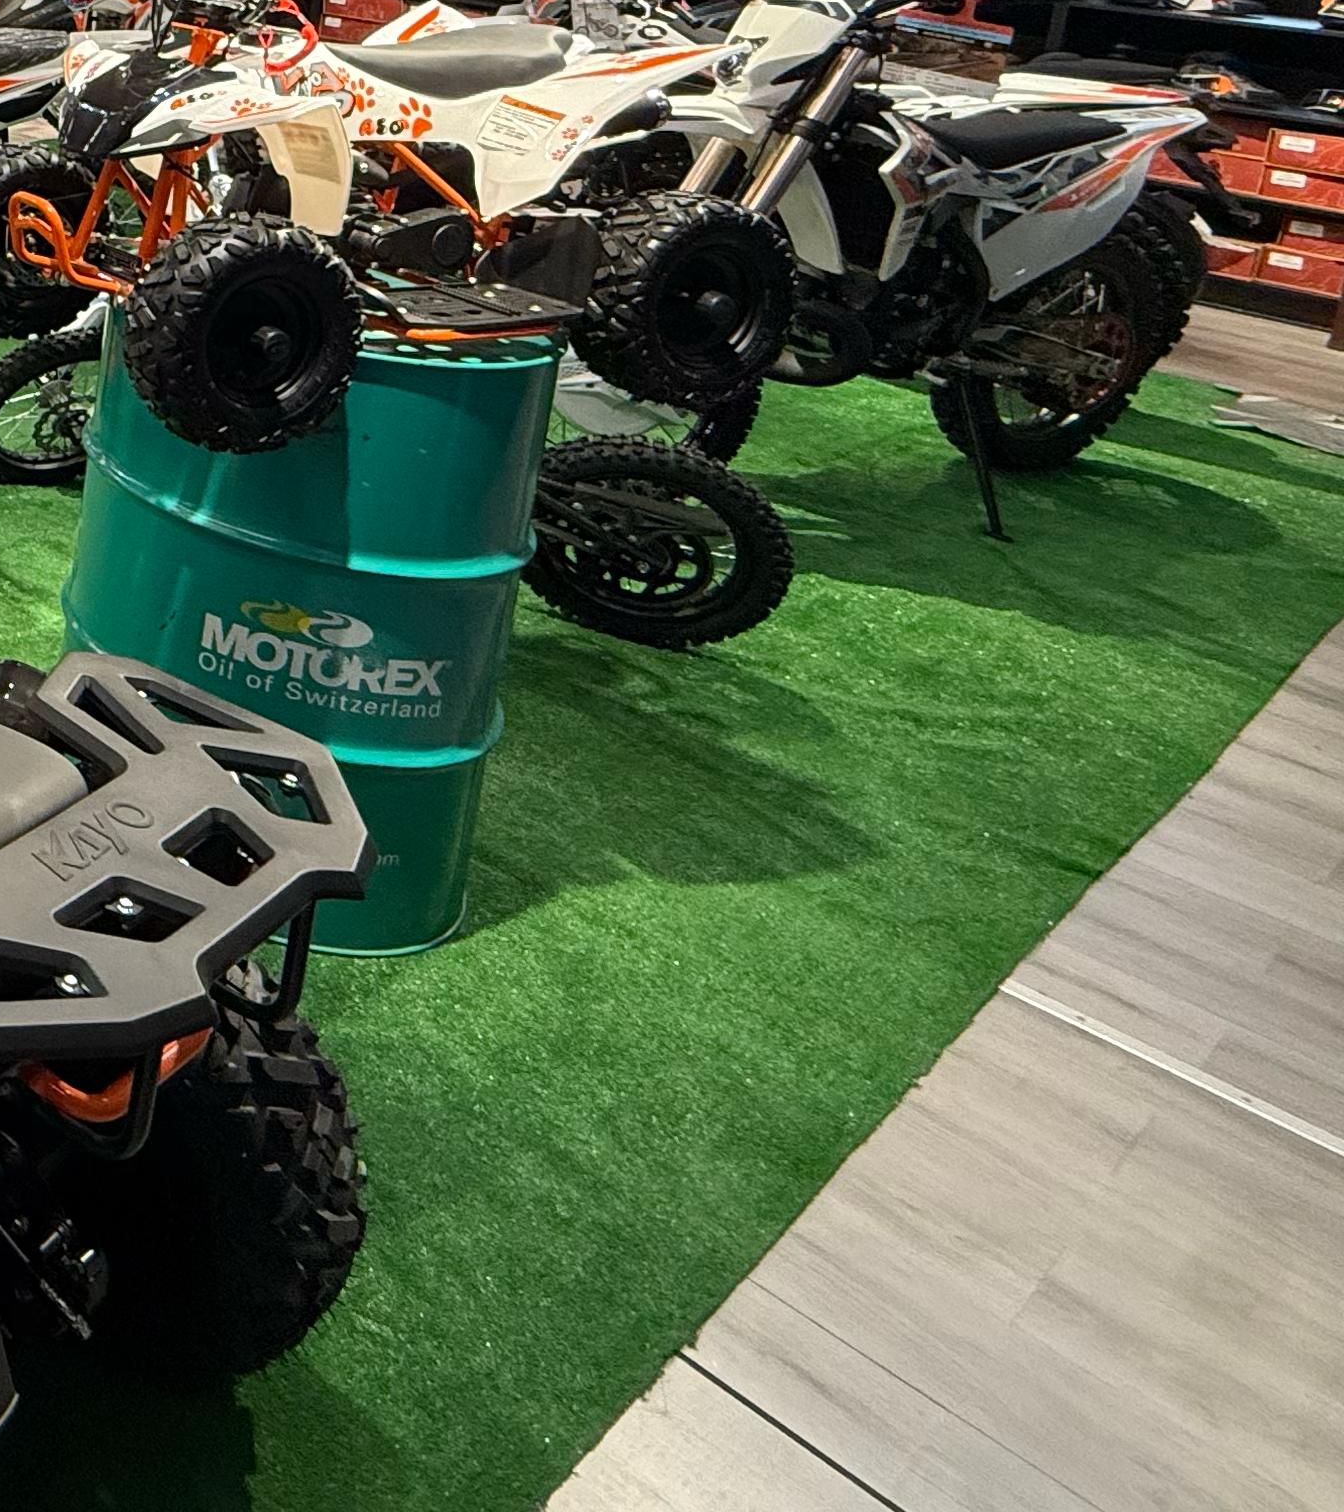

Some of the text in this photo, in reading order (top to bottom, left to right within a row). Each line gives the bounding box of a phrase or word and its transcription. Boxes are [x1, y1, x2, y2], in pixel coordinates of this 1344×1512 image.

[198, 651, 442, 719] Oil of Switzerland
[201, 612, 446, 697] MOTOREX
[30, 801, 155, 882] KAYO
